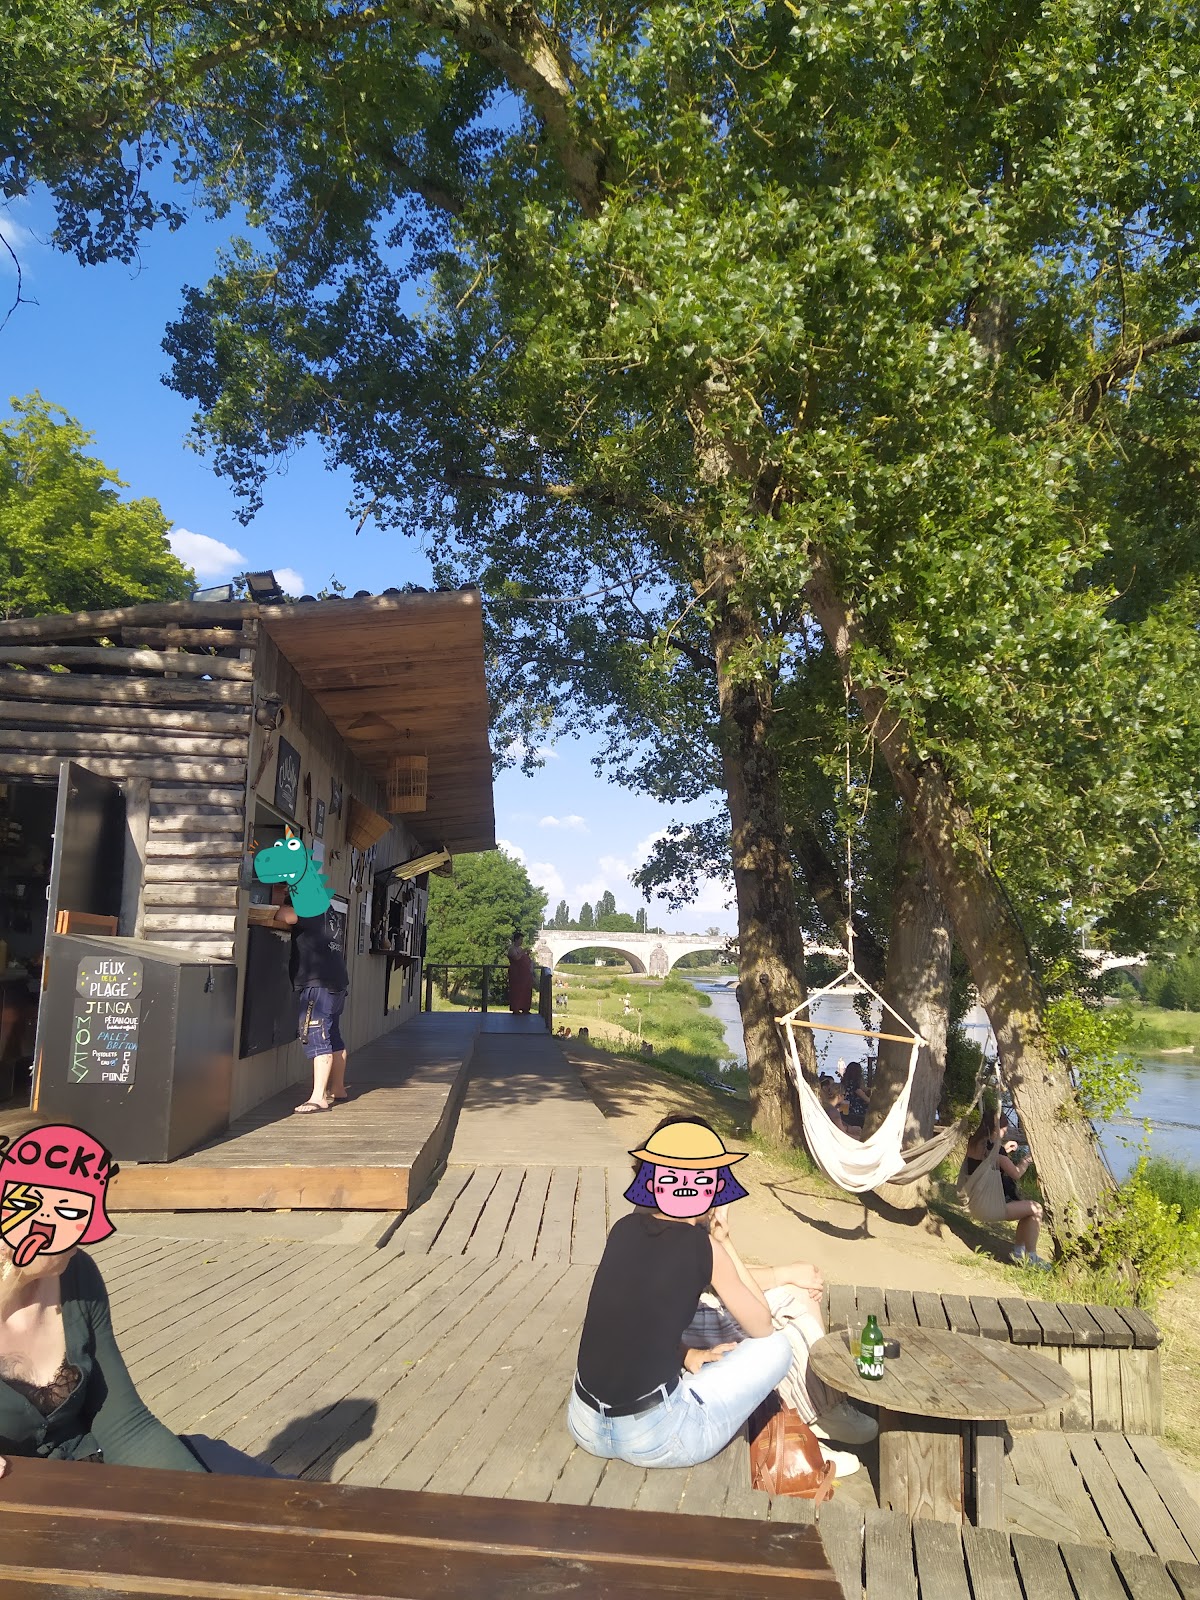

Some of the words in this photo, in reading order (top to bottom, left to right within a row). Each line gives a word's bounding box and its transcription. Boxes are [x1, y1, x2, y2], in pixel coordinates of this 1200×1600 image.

[94, 961, 126, 975] JEUX
[90, 982, 129, 997] PLAGE
[85, 1001, 134, 1014] JENGA
[104, 1015, 139, 1025] PÉTANQUE
[97, 1031, 129, 1041] PALET
